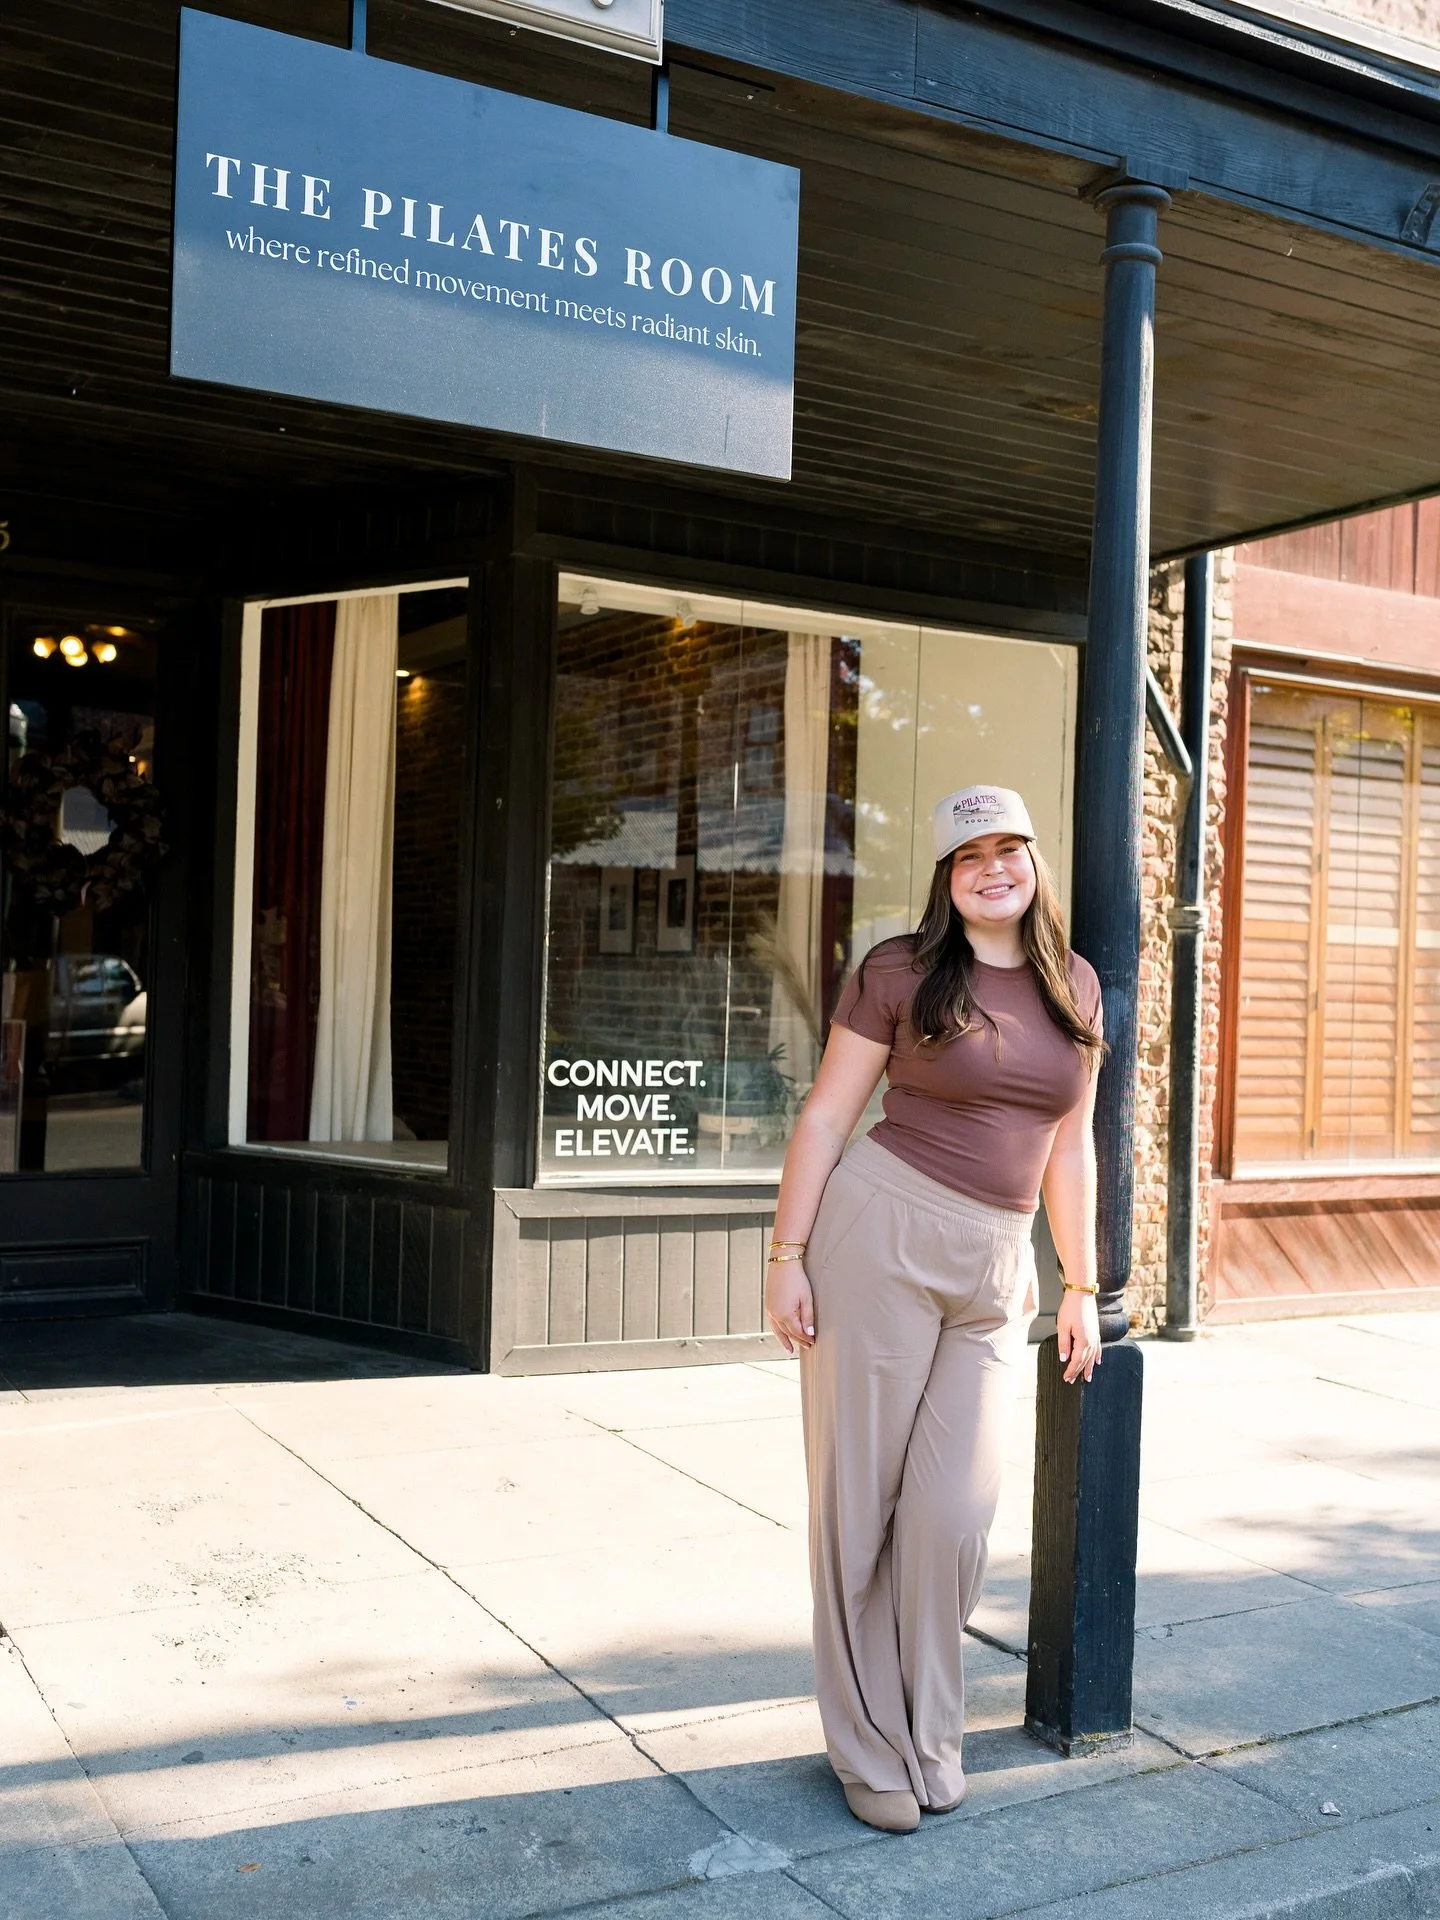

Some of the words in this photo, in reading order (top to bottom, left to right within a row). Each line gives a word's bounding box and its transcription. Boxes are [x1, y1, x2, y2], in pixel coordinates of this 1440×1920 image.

[206, 152, 331, 220] THE
[360, 188, 598, 277] PILATES
[623, 247, 777, 317] ROOM
[225, 225, 311, 264] where
[317, 248, 409, 285] refined
[415, 270, 550, 313] movement
[554, 299, 626, 329] meets
[631, 313, 711, 346] radiant
[715, 326, 763, 358] skin.
[961, 795, 997, 808] PILATES
[547, 1059, 707, 1088] CONNECT.
[576, 1094, 677, 1122] MOVE.
[554, 1128, 696, 1157] ELEVATE.
